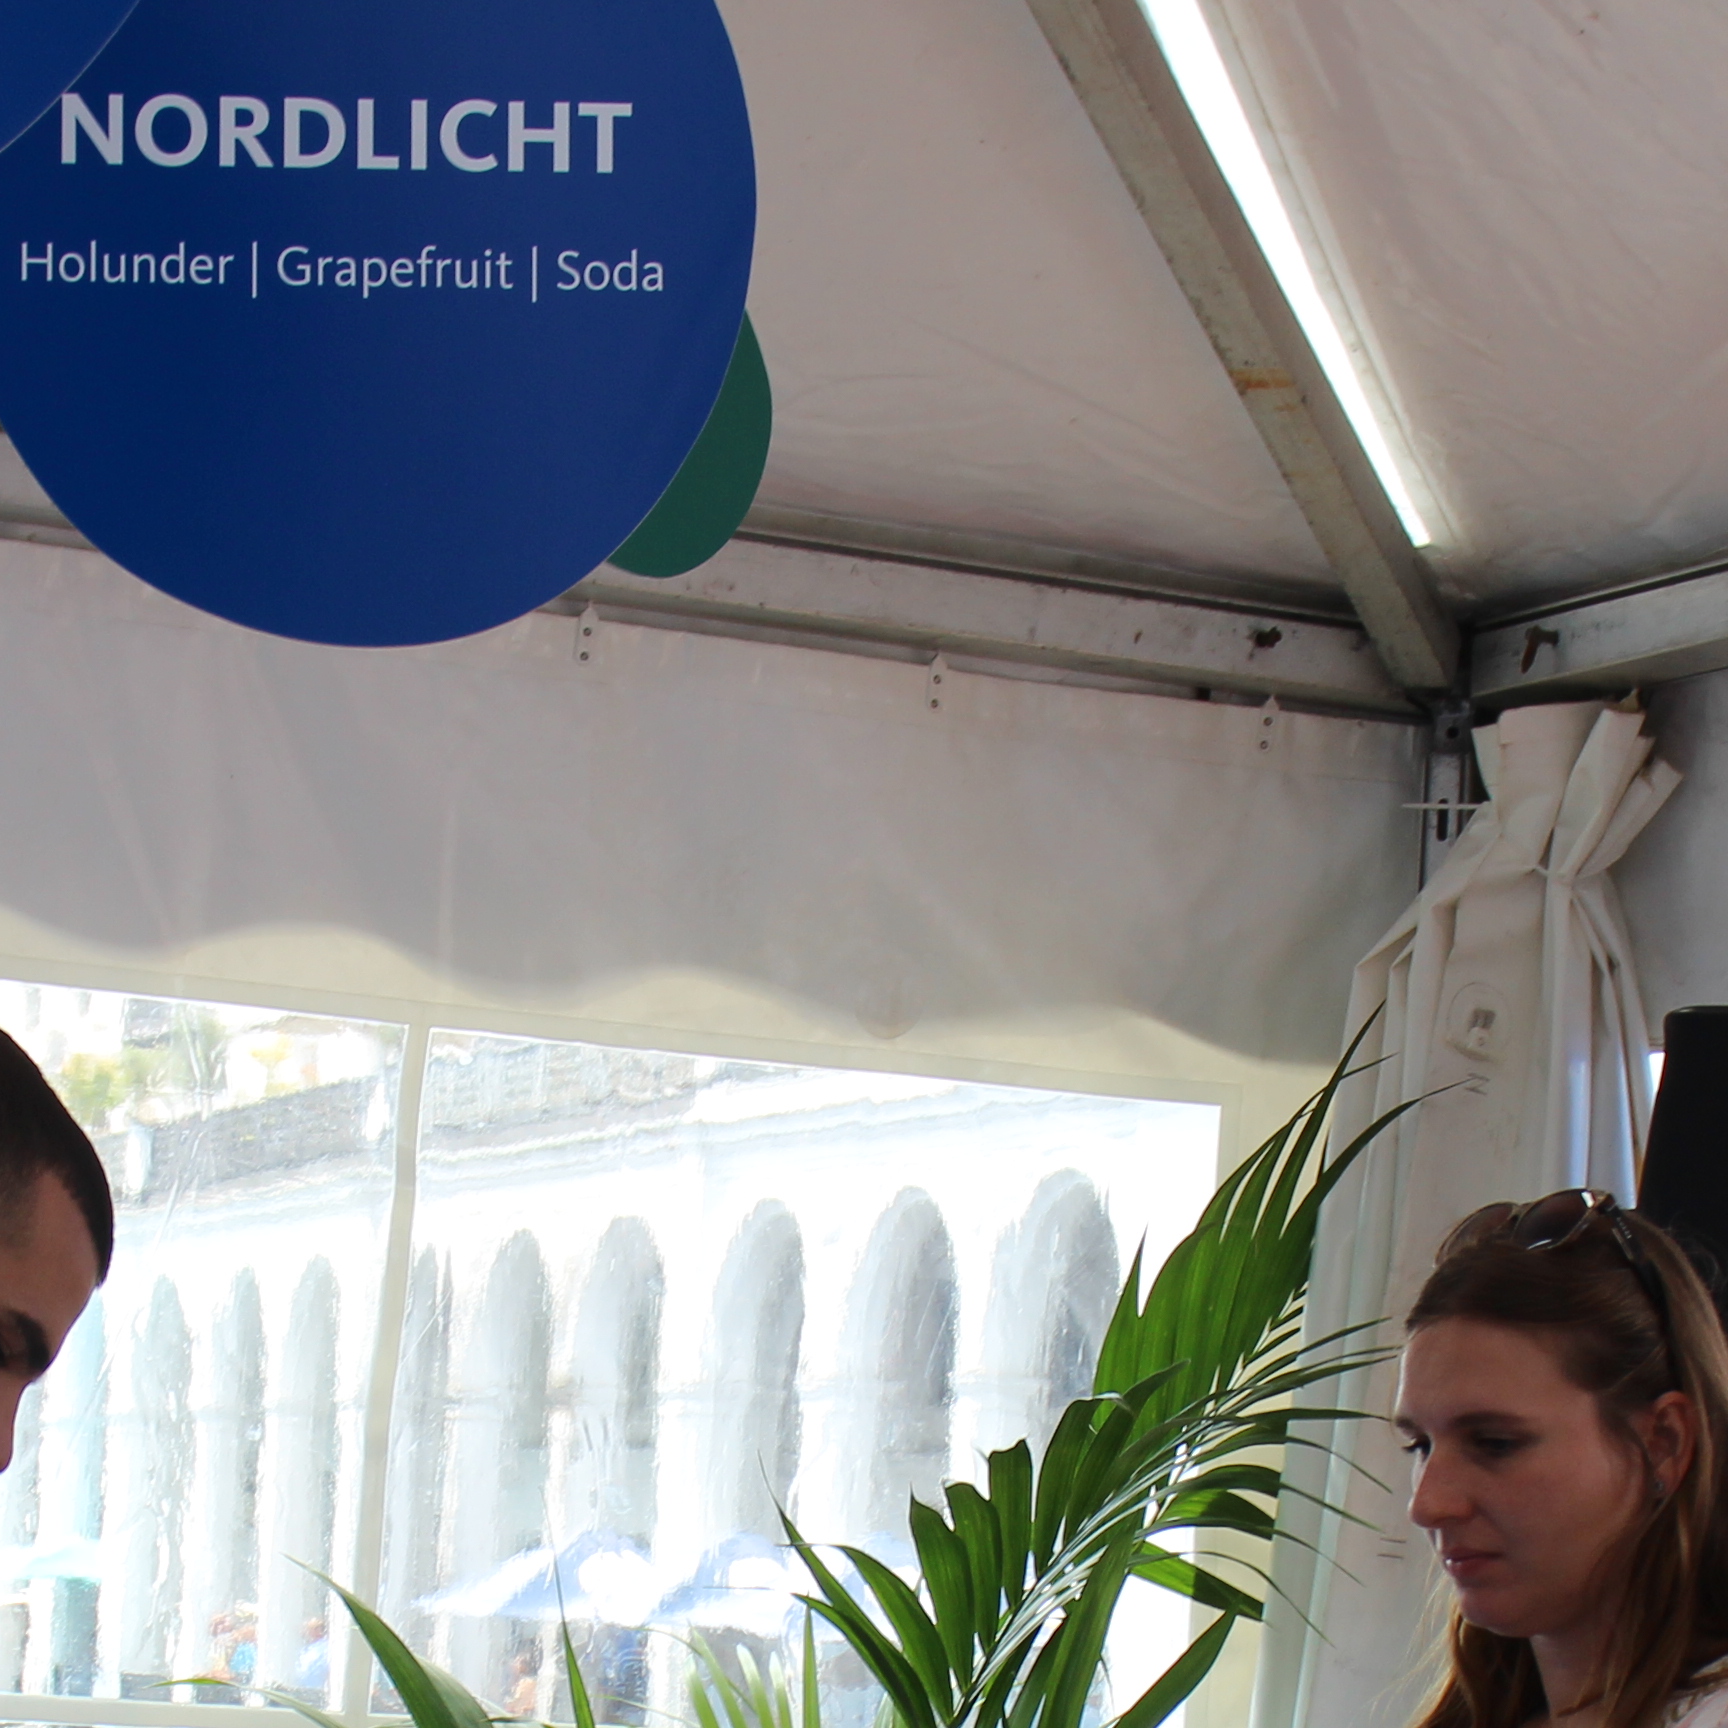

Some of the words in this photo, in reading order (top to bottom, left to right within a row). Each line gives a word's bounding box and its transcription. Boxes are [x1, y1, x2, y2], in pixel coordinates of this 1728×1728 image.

[59, 92, 634, 174] NORDLICHT
[20, 240, 235, 285] Holunder
[276, 244, 514, 299] Grapefruit
[556, 249, 664, 292] Soda
